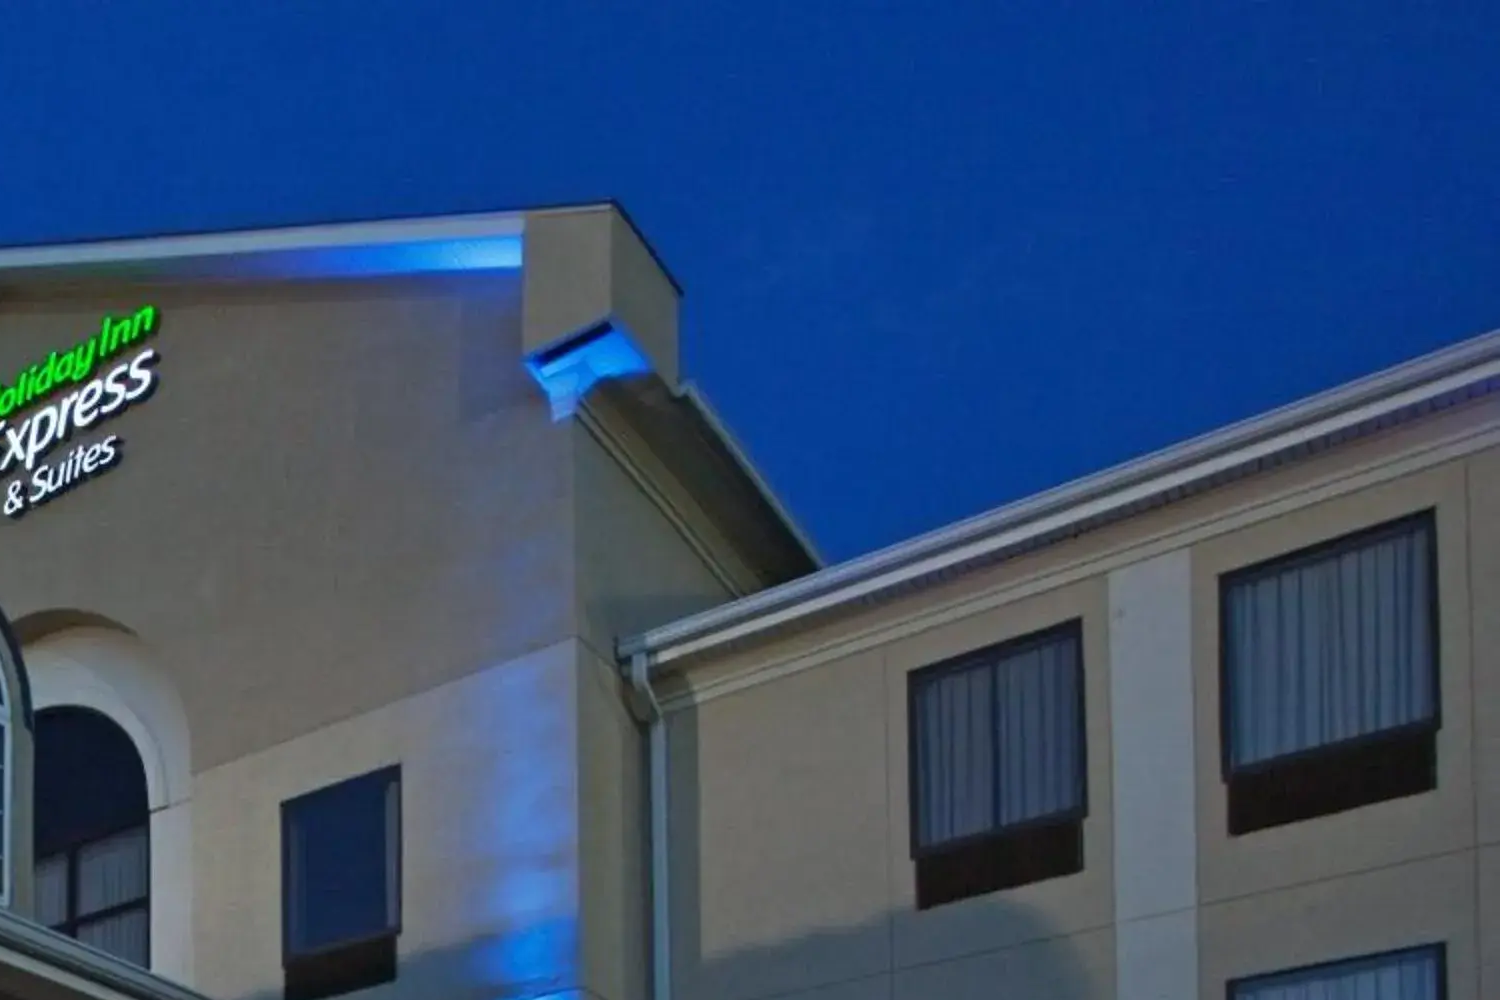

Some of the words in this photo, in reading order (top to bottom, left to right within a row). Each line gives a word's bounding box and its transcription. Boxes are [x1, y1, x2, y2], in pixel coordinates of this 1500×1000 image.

[99, 304, 156, 356] Inn
[3, 479, 24, 516] &
[30, 435, 117, 503] Suites
